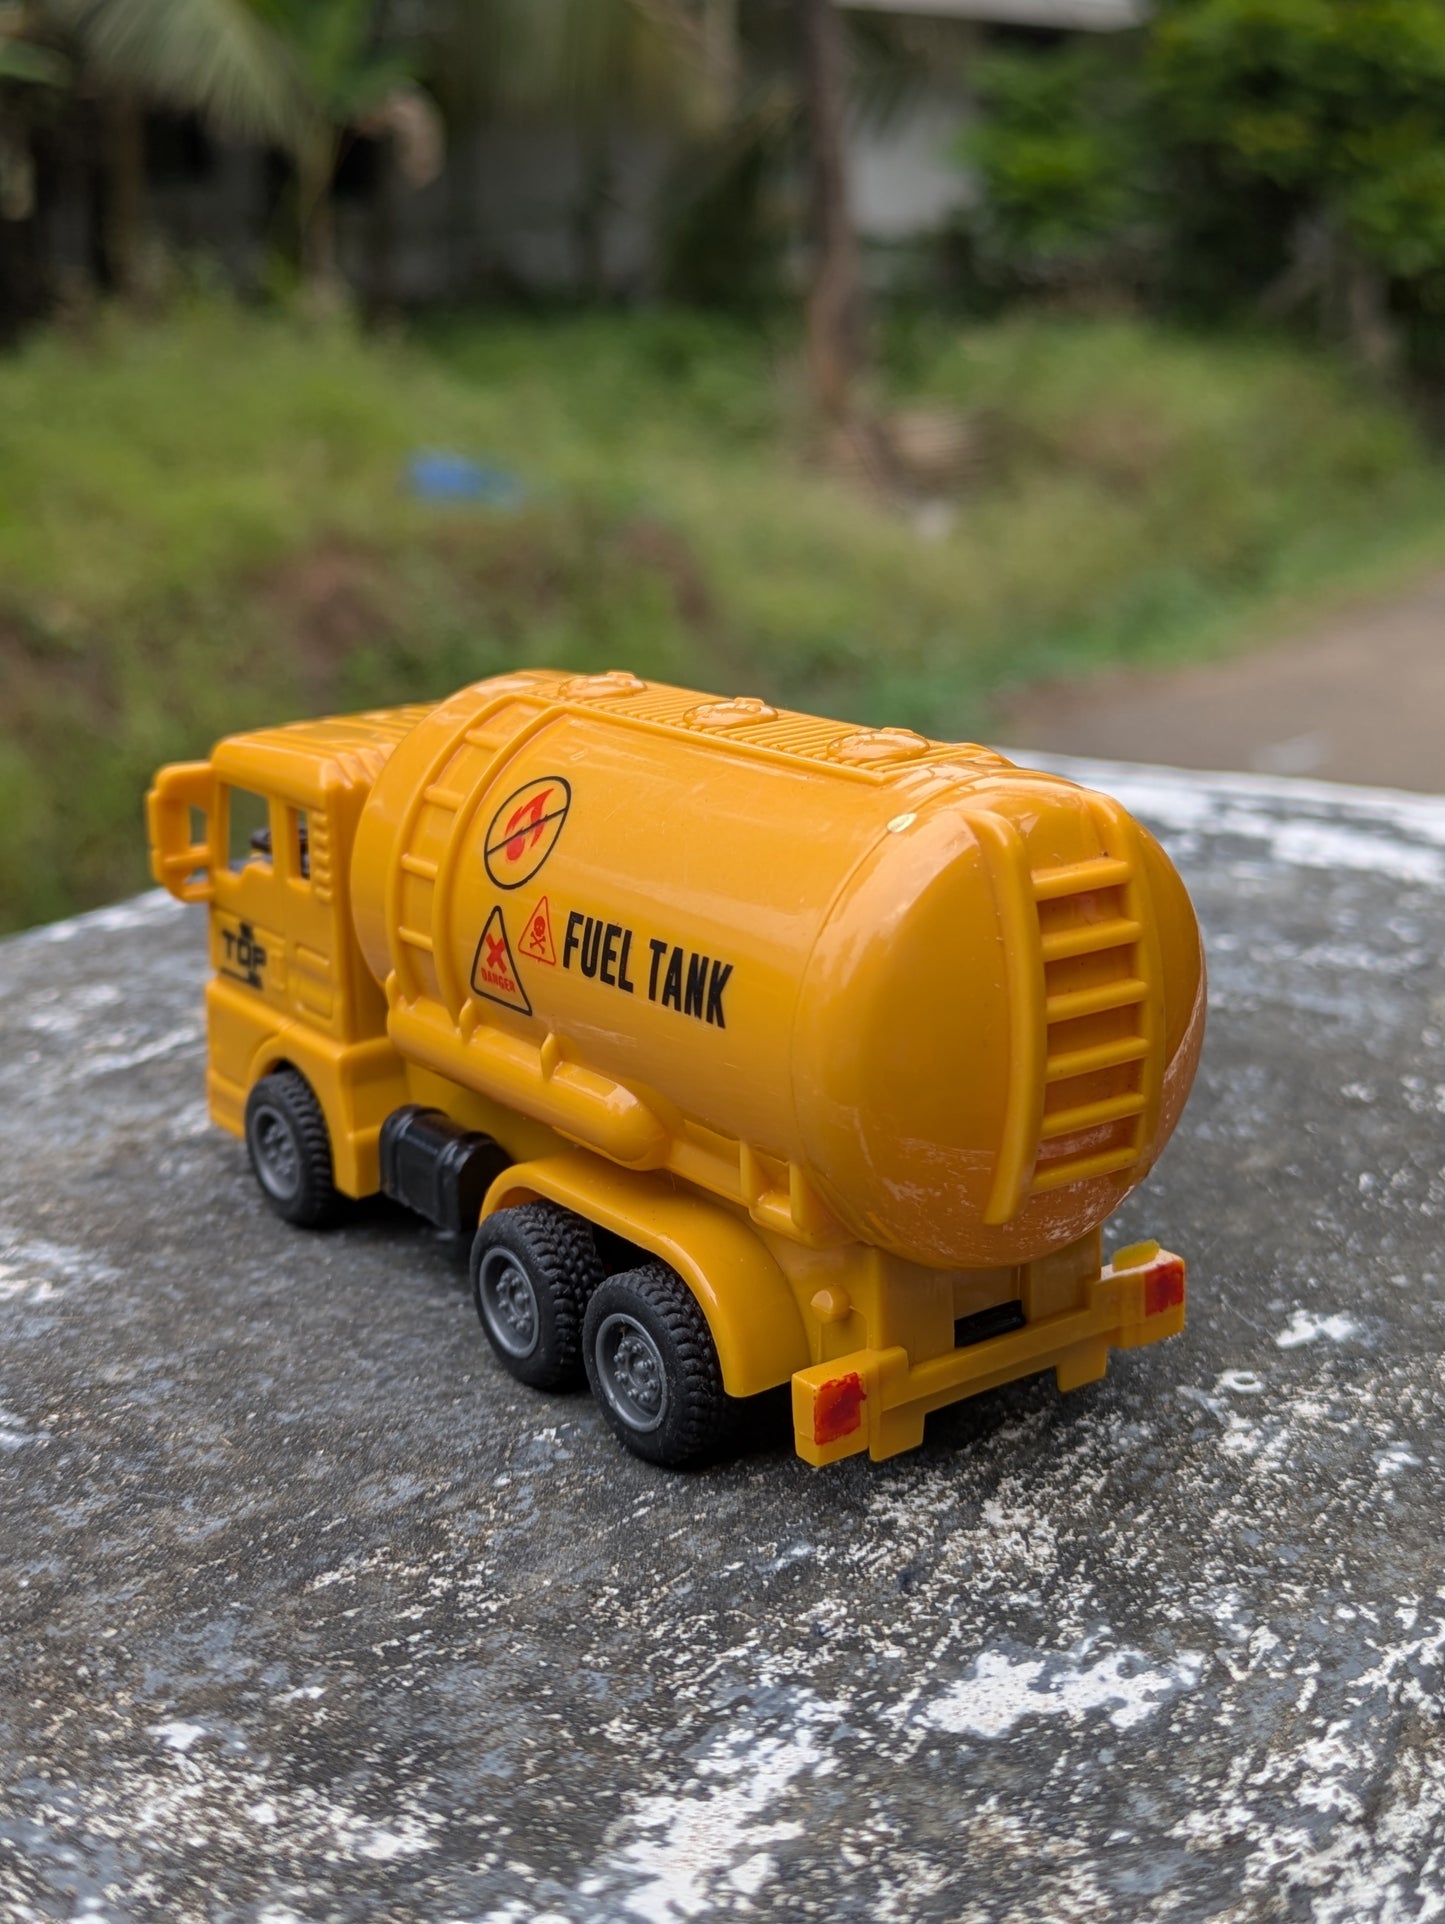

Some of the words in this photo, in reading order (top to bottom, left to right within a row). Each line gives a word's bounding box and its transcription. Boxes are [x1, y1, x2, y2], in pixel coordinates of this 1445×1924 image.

[221, 928, 267, 973] TOP
[563, 911, 634, 993] FUEL
[648, 938, 734, 1029] TANK
[480, 967, 516, 993] DANGER
